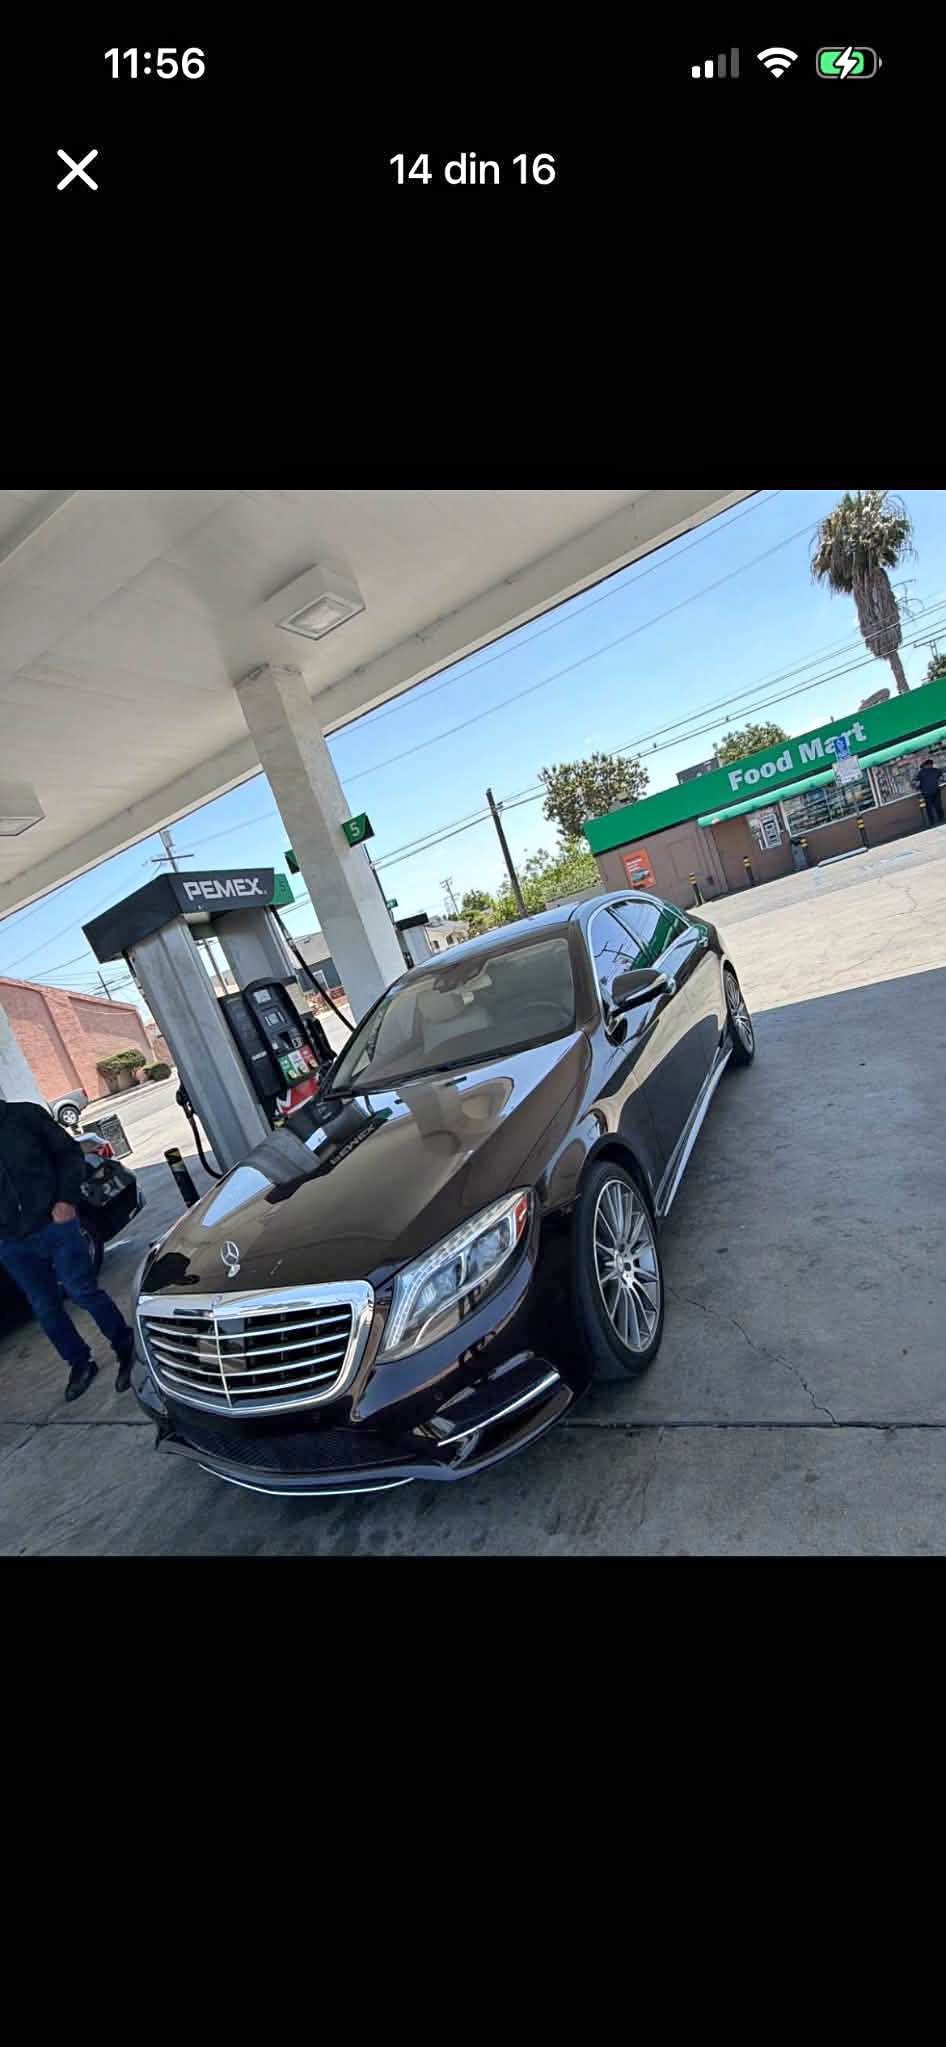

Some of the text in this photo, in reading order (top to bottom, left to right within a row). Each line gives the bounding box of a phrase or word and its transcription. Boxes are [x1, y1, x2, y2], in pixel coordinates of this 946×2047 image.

[728, 750, 793, 792] Food
[798, 721, 867, 764] Mart
[349, 821, 360, 837] 5
[183, 878, 264, 900] PEMEX
